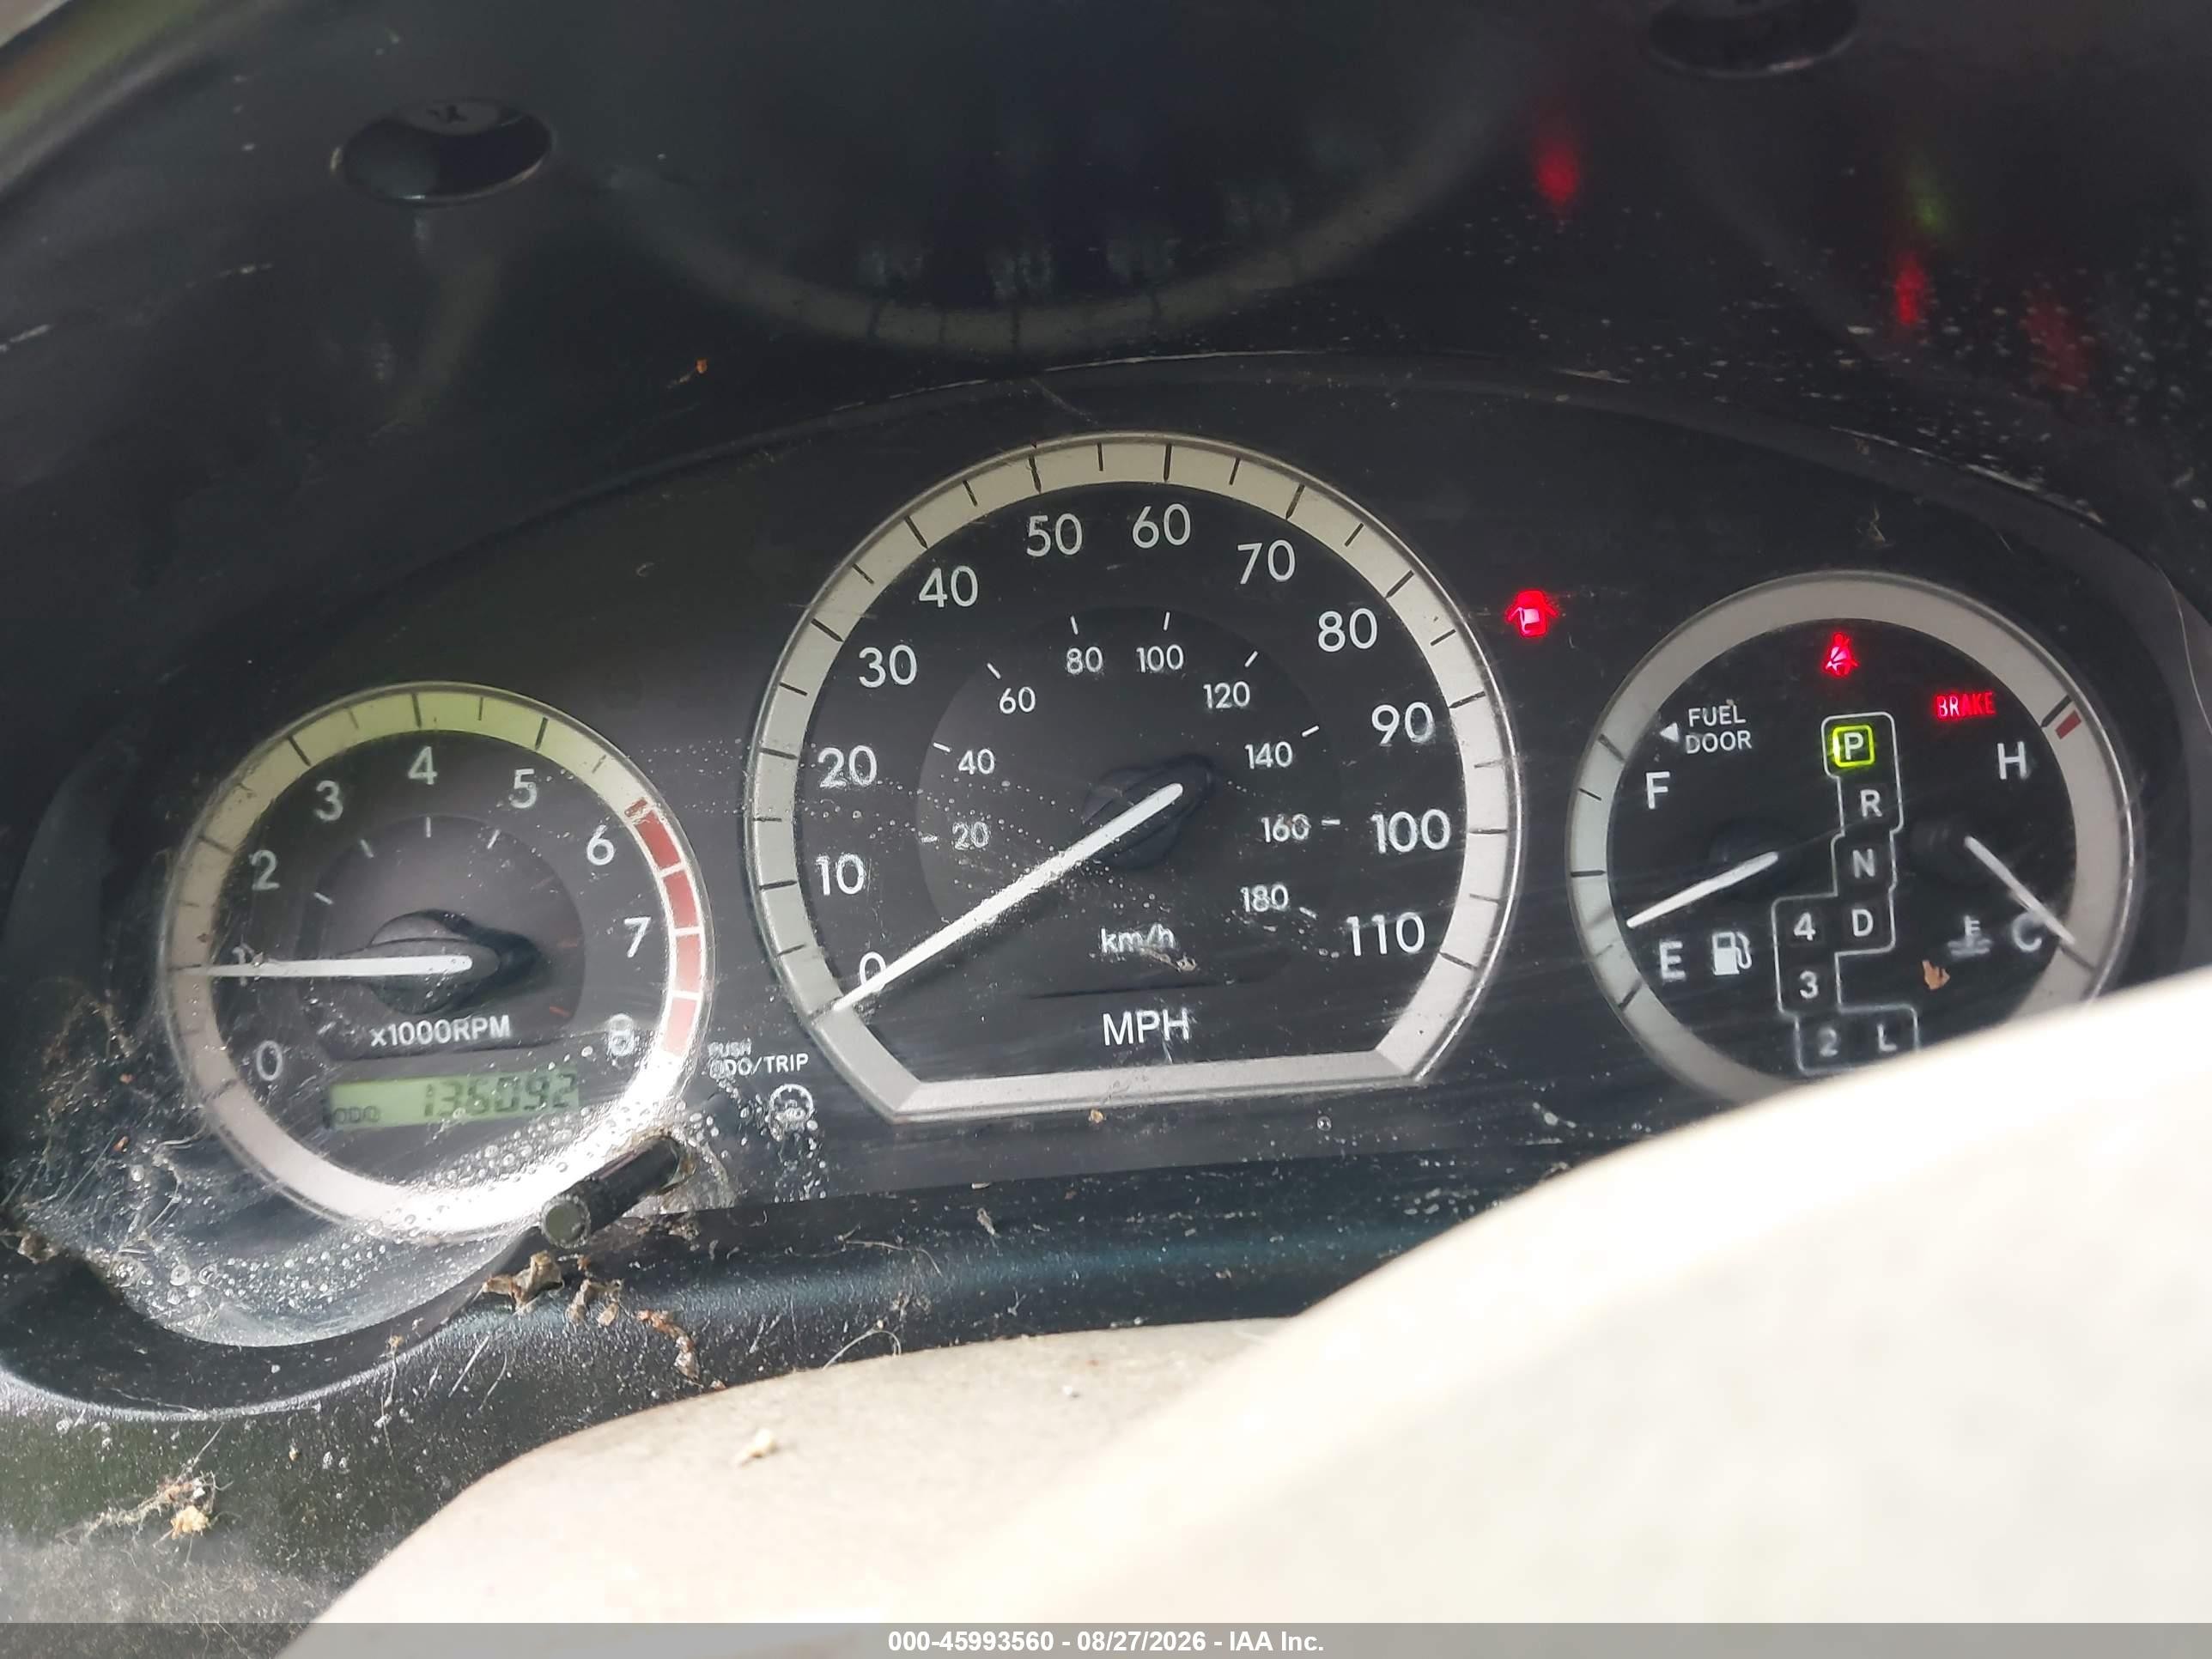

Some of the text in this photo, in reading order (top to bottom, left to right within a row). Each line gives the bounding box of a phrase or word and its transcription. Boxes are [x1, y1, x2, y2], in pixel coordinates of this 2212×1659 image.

[1026, 513, 1084, 557] 50
[1132, 503, 1192, 549] 60
[1237, 539, 1296, 585] 70
[918, 565, 979, 608] 40
[1317, 607, 1378, 653] 80
[859, 644, 917, 688] 30
[1066, 646, 1103, 675] 80
[1136, 644, 1184, 673] 100
[999, 686, 1036, 714] 60
[1202, 680, 1250, 709] 120
[1936, 691, 1996, 720] BRAKE
[1371, 702, 1435, 746] 90
[1687, 704, 1747, 729] FUEL
[957, 748, 996, 775] 40
[1245, 741, 1293, 769] 140
[1685, 730, 1753, 755] DOOR
[1844, 732, 1864, 760] P
[1996, 740, 2028, 780] H
[407, 745, 438, 785] 4
[817, 744, 878, 789] 20
[314, 779, 344, 822] 3
[513, 769, 538, 810] 5
[1645, 771, 1670, 810] F
[1861, 790, 1883, 818] R
[586, 823, 615, 867] 6
[952, 822, 988, 850] 20
[1261, 814, 1311, 842] 160
[1371, 809, 1451, 854] 100
[249, 849, 281, 890] 2
[817, 854, 865, 896] 10
[1852, 848, 1875, 878] N
[1241, 884, 1290, 914] 180
[624, 916, 652, 958] 7
[1100, 923, 1176, 953] km/h
[1346, 911, 1425, 957] 110
[1794, 913, 1815, 940] 4
[1851, 908, 1875, 938] D
[2012, 912, 2043, 951] C
[1659, 941, 1686, 981] E
[1799, 970, 1819, 999] 3
[607, 1013, 635, 1057] 8
[1103, 1008, 1191, 1047] MPH
[1819, 1030, 1839, 1057] 2
[1877, 1024, 1898, 1052] L
[256, 1040, 283, 1081] 0
[709, 1053, 809, 1079] ODO/TRIP
[423, 1072, 579, 1118] 136092
